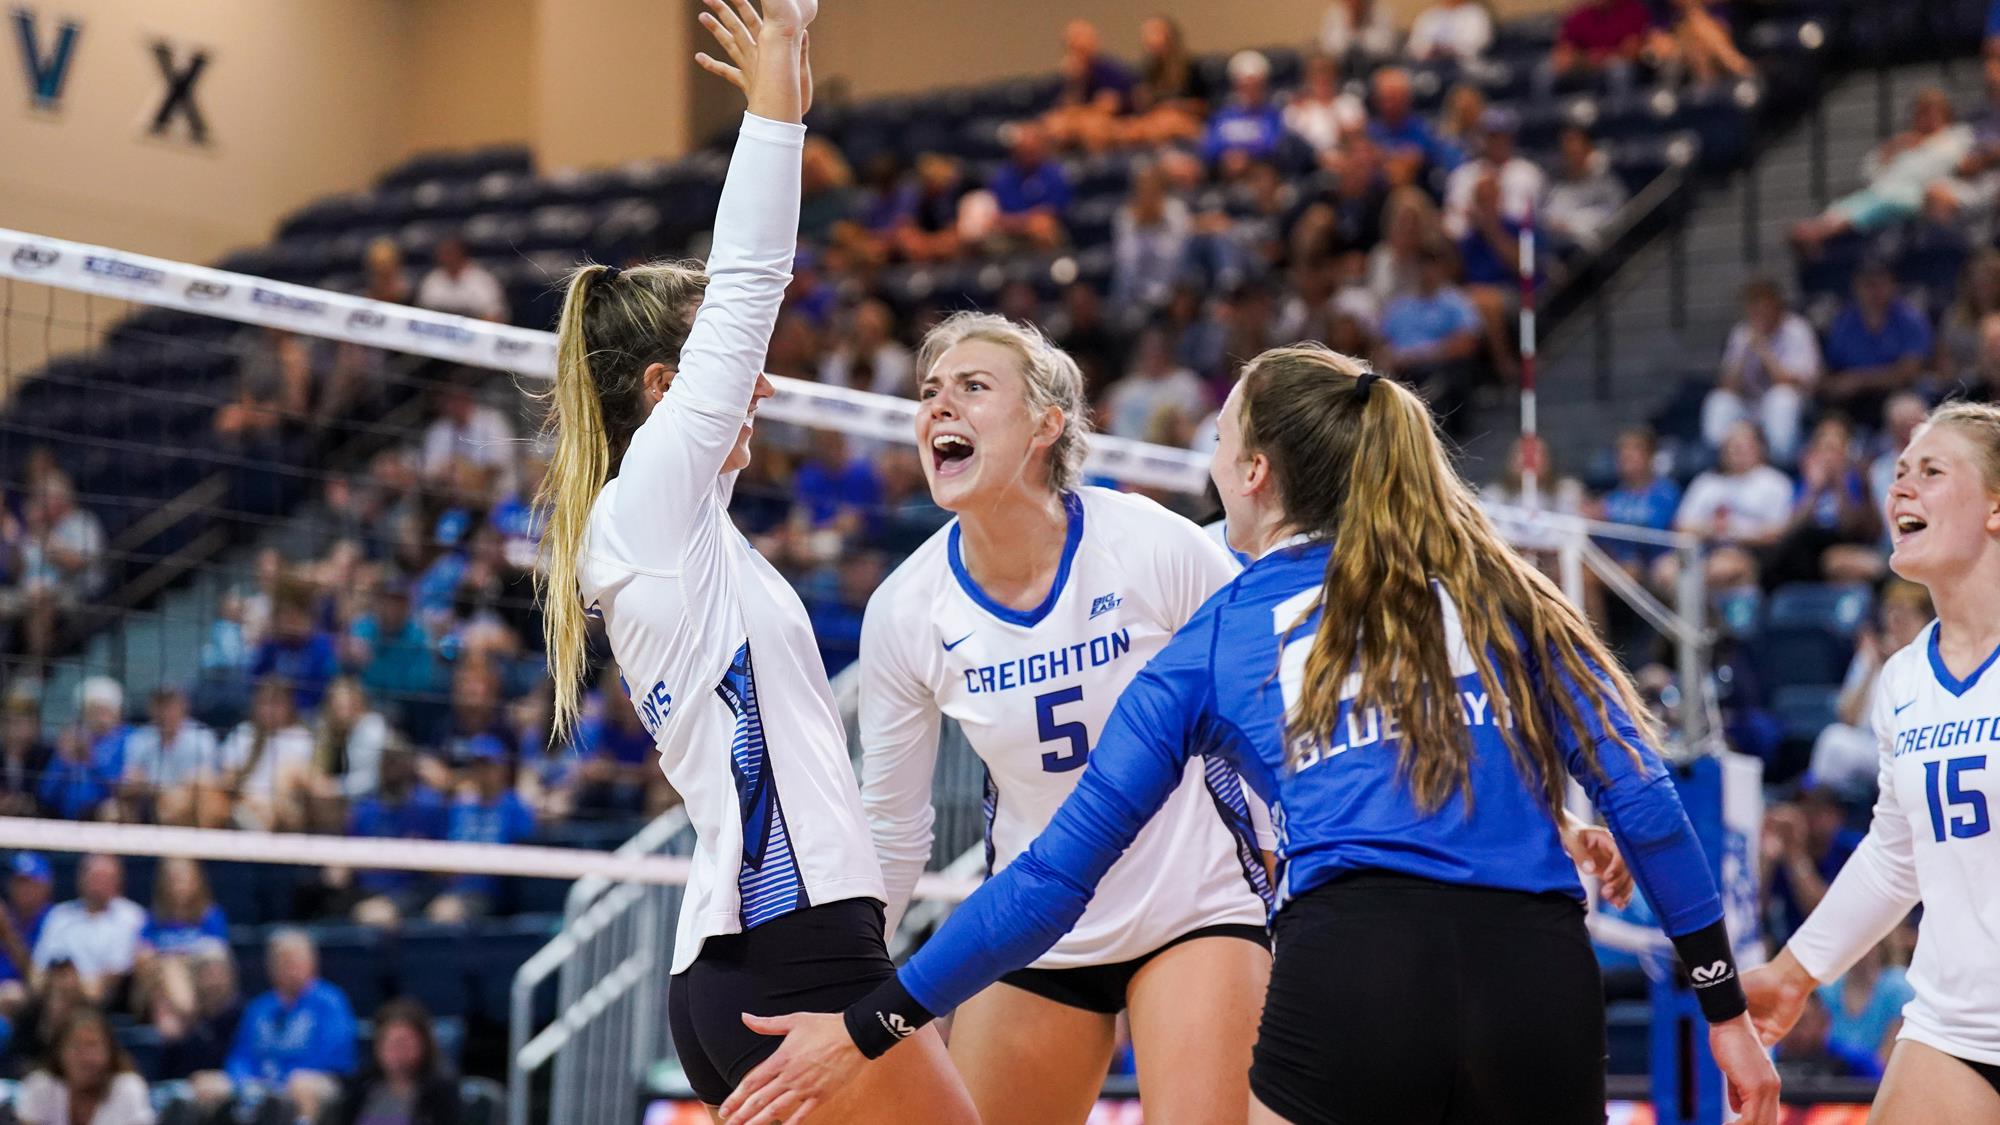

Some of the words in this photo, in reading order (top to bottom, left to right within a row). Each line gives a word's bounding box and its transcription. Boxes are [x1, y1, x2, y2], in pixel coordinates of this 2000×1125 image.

[149, 40, 208, 142] X
[964, 628, 1130, 693] CREIGHTON
[1034, 685, 1090, 773] 5
[1923, 755, 1991, 843] 15
